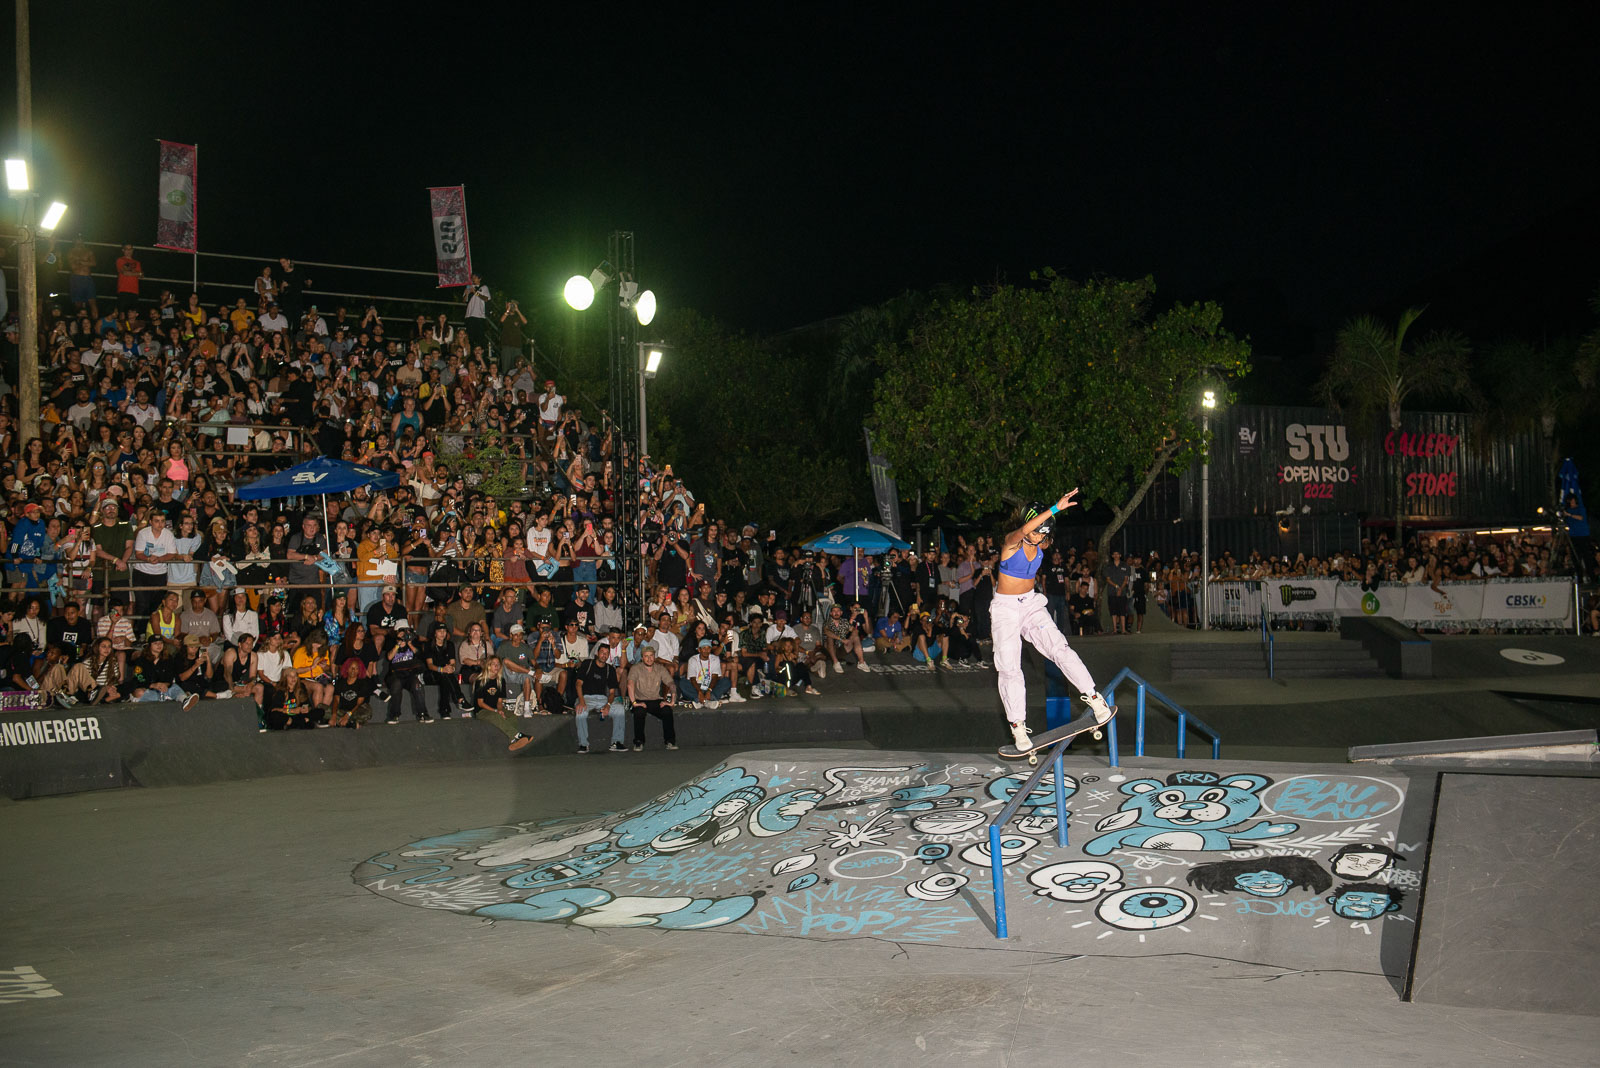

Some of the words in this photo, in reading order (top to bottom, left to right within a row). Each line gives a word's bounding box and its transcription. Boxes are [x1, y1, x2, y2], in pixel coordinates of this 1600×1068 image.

[1286, 423, 1350, 462] STU
[1384, 431, 1459, 458] GALLERY
[1283, 465, 1321, 483] OPEN
[1405, 472, 1458, 498] STORE
[1303, 483, 1334, 499] 2022
[1506, 594, 1537, 606] CBSK
[1221, 847, 1265, 859] YOU
[800, 909, 913, 936] POP!
